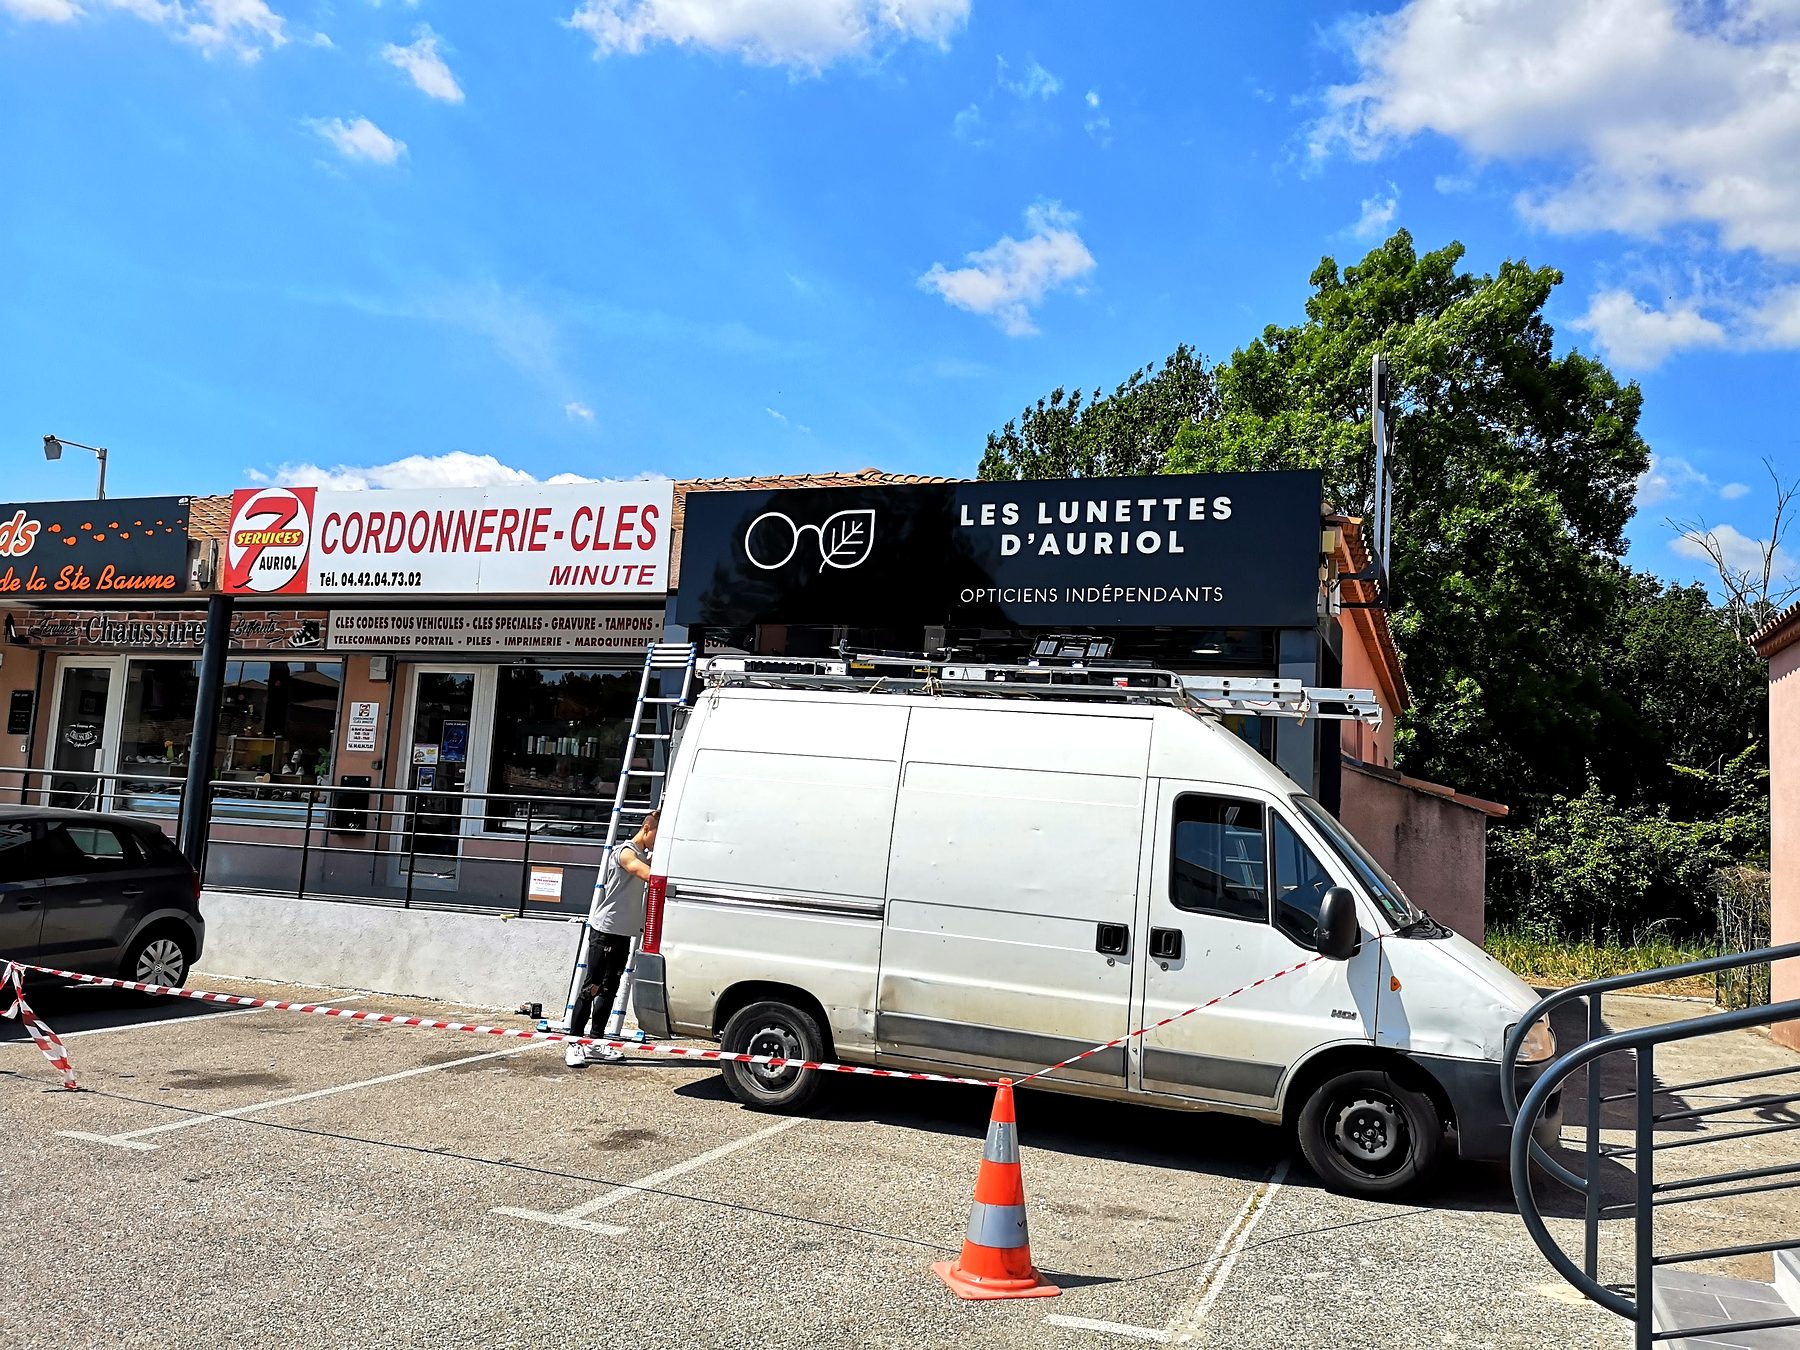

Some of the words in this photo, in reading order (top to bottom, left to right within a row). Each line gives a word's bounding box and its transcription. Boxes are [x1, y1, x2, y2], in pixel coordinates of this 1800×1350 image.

[960, 502, 1020, 526] LES
[1037, 496, 1233, 524] LUNETTES
[236, 531, 301, 545] SERVICES
[1000, 530, 1185, 556] D'AURIOL
[259, 555, 298, 571] AURIOL
[26, 565, 48, 592] la
[54, 564, 91, 591] Ste
[96, 564, 176, 591] Baume
[320, 572, 338, 587] Tél.
[341, 571, 422, 587] 04.42.04.73.02
[549, 565, 657, 586] MINUTE
[960, 588, 1058, 603] OPTICIENS
[1065, 584, 1224, 603] INDÉPENDANTS
[86, 616, 206, 644] Chaussure
[335, 616, 355, 629] CLES
[356, 616, 389, 630] CODEES
[391, 617, 414, 630] TOUS
[416, 617, 464, 630] VEHICULES
[472, 617, 493, 630] CLES
[495, 617, 543, 630] SPECIALES
[551, 617, 596, 630] GRAVURE
[605, 617, 653, 630] TAMPONS
[334, 635, 411, 645] TELECOMMANDES
[415, 636, 454, 646] PORTAIL
[466, 636, 492, 646] PILES
[504, 636, 562, 646] IMPRIMERIE
